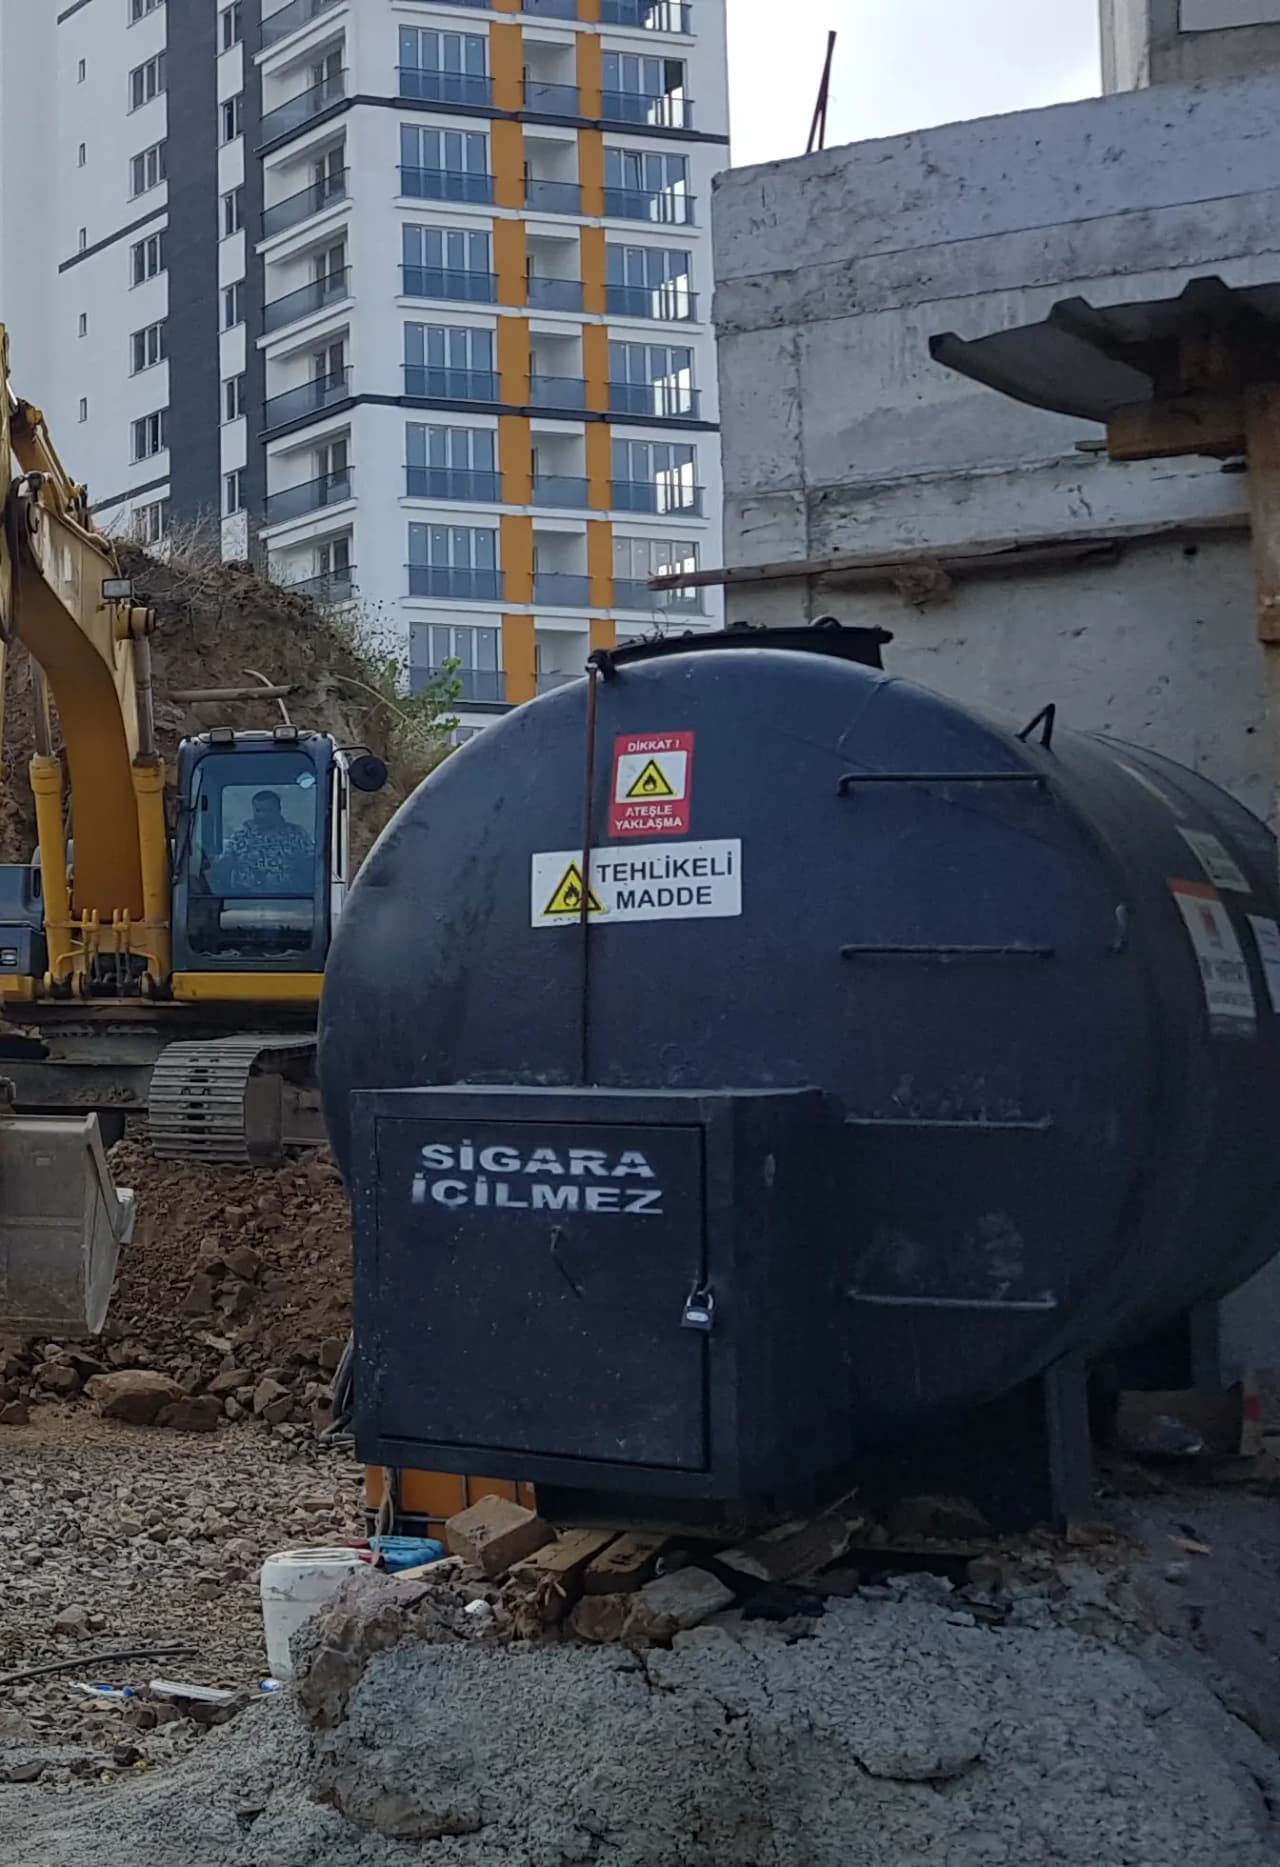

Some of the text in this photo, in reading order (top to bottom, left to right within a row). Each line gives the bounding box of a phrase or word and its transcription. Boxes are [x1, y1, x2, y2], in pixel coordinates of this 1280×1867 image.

[627, 738, 673, 752] DİKKAT
[625, 804, 673, 818] ATEŞLE
[615, 817, 682, 830] YAKLAŞMA
[596, 851, 733, 882] TEHLİKELİ
[616, 886, 713, 909] MADDE
[421, 1139, 656, 1178] SİGARA
[411, 1173, 664, 1214] İÇİLMEZ
